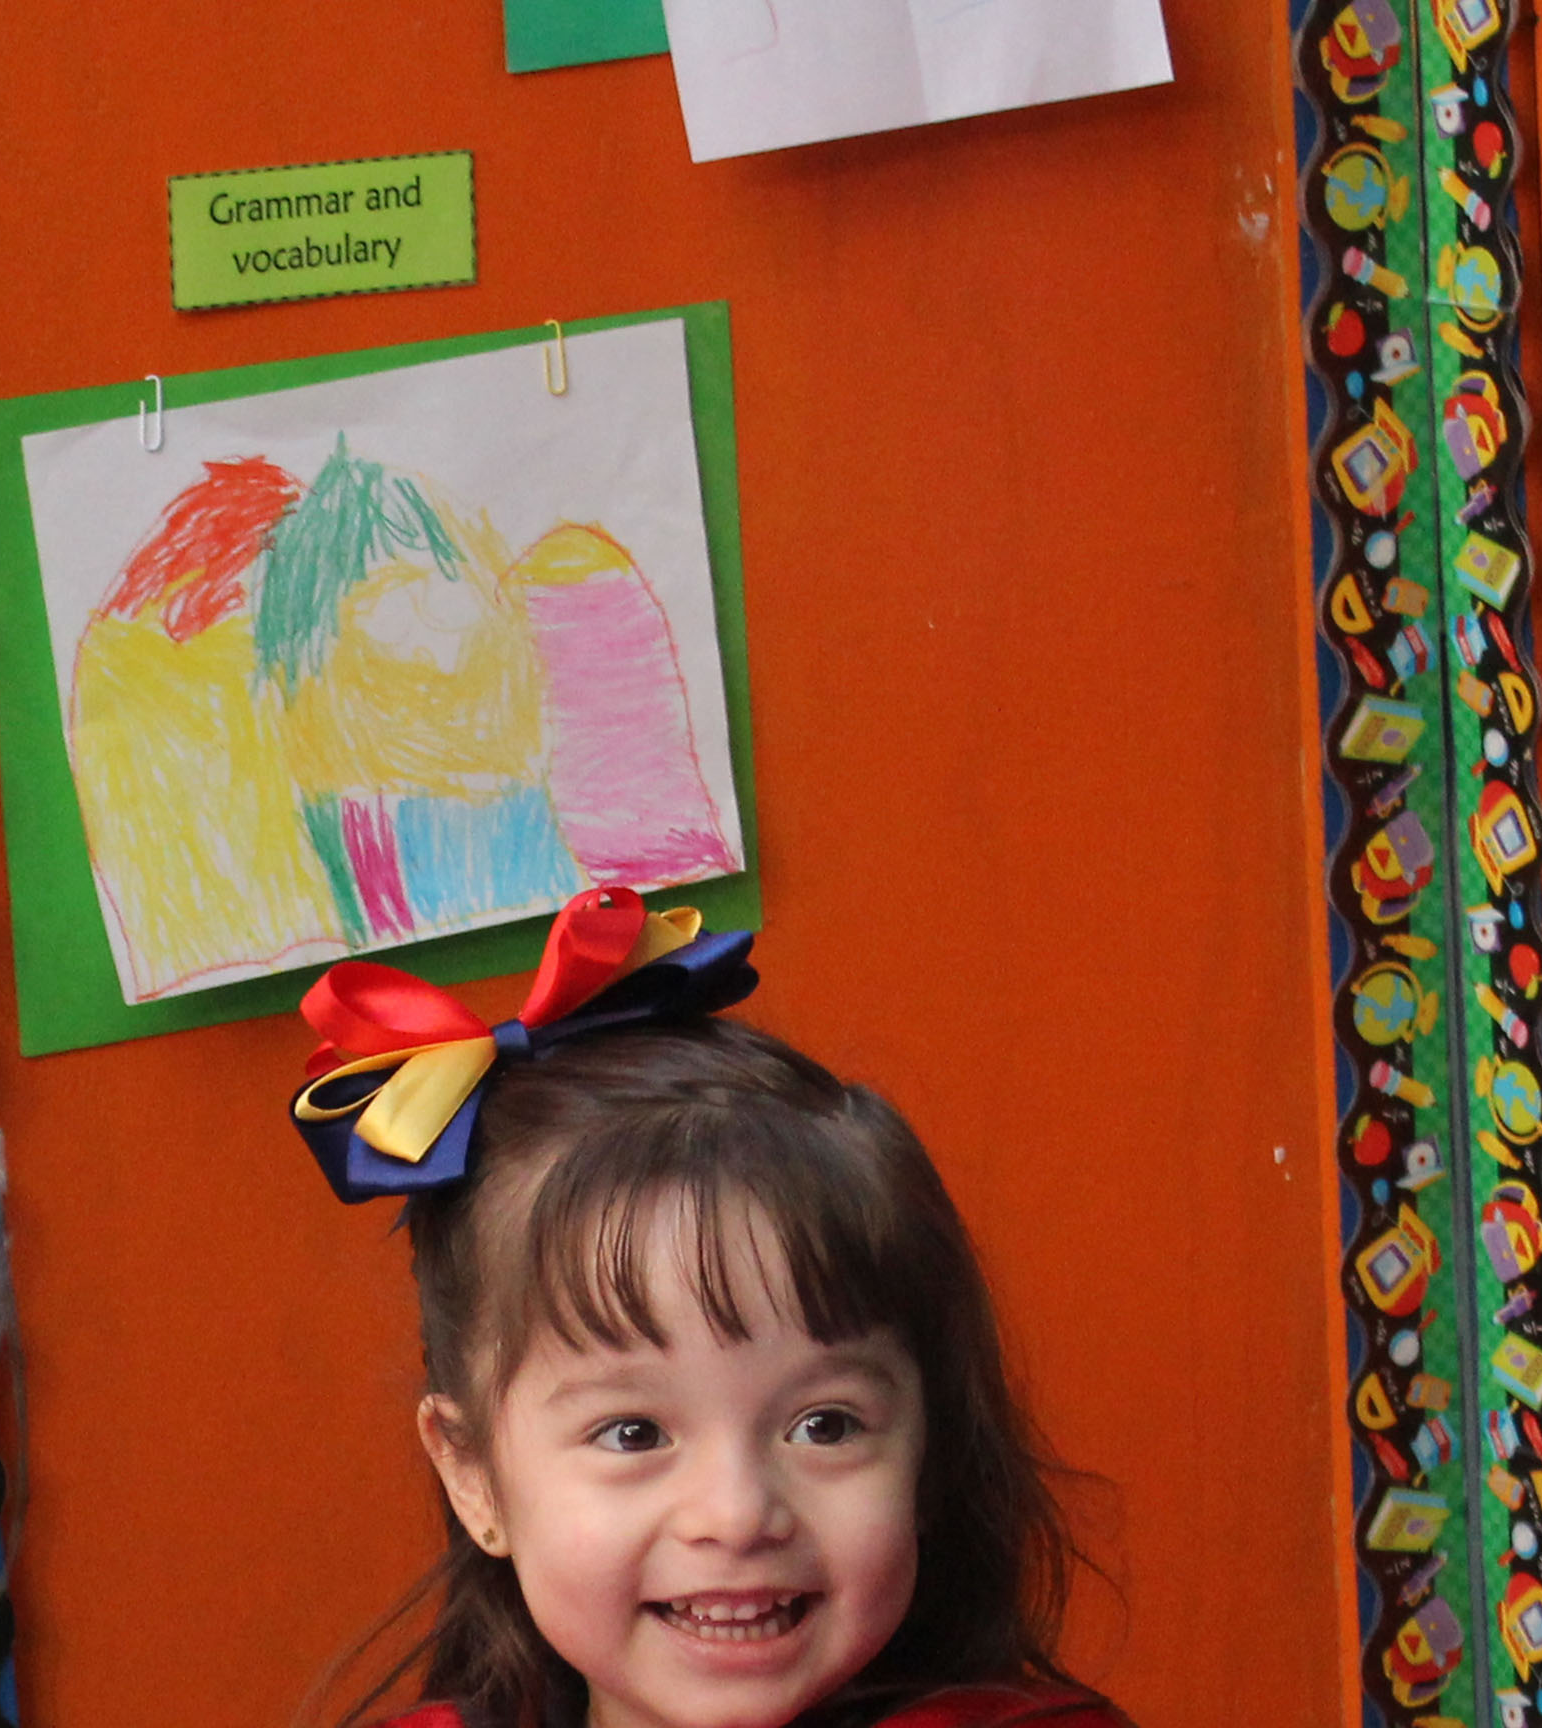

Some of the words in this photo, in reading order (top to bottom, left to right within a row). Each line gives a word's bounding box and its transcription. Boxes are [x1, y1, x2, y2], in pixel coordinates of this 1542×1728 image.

[209, 187, 354, 226] Grammar
[364, 175, 423, 209] and
[232, 232, 402, 275] vocabulary
